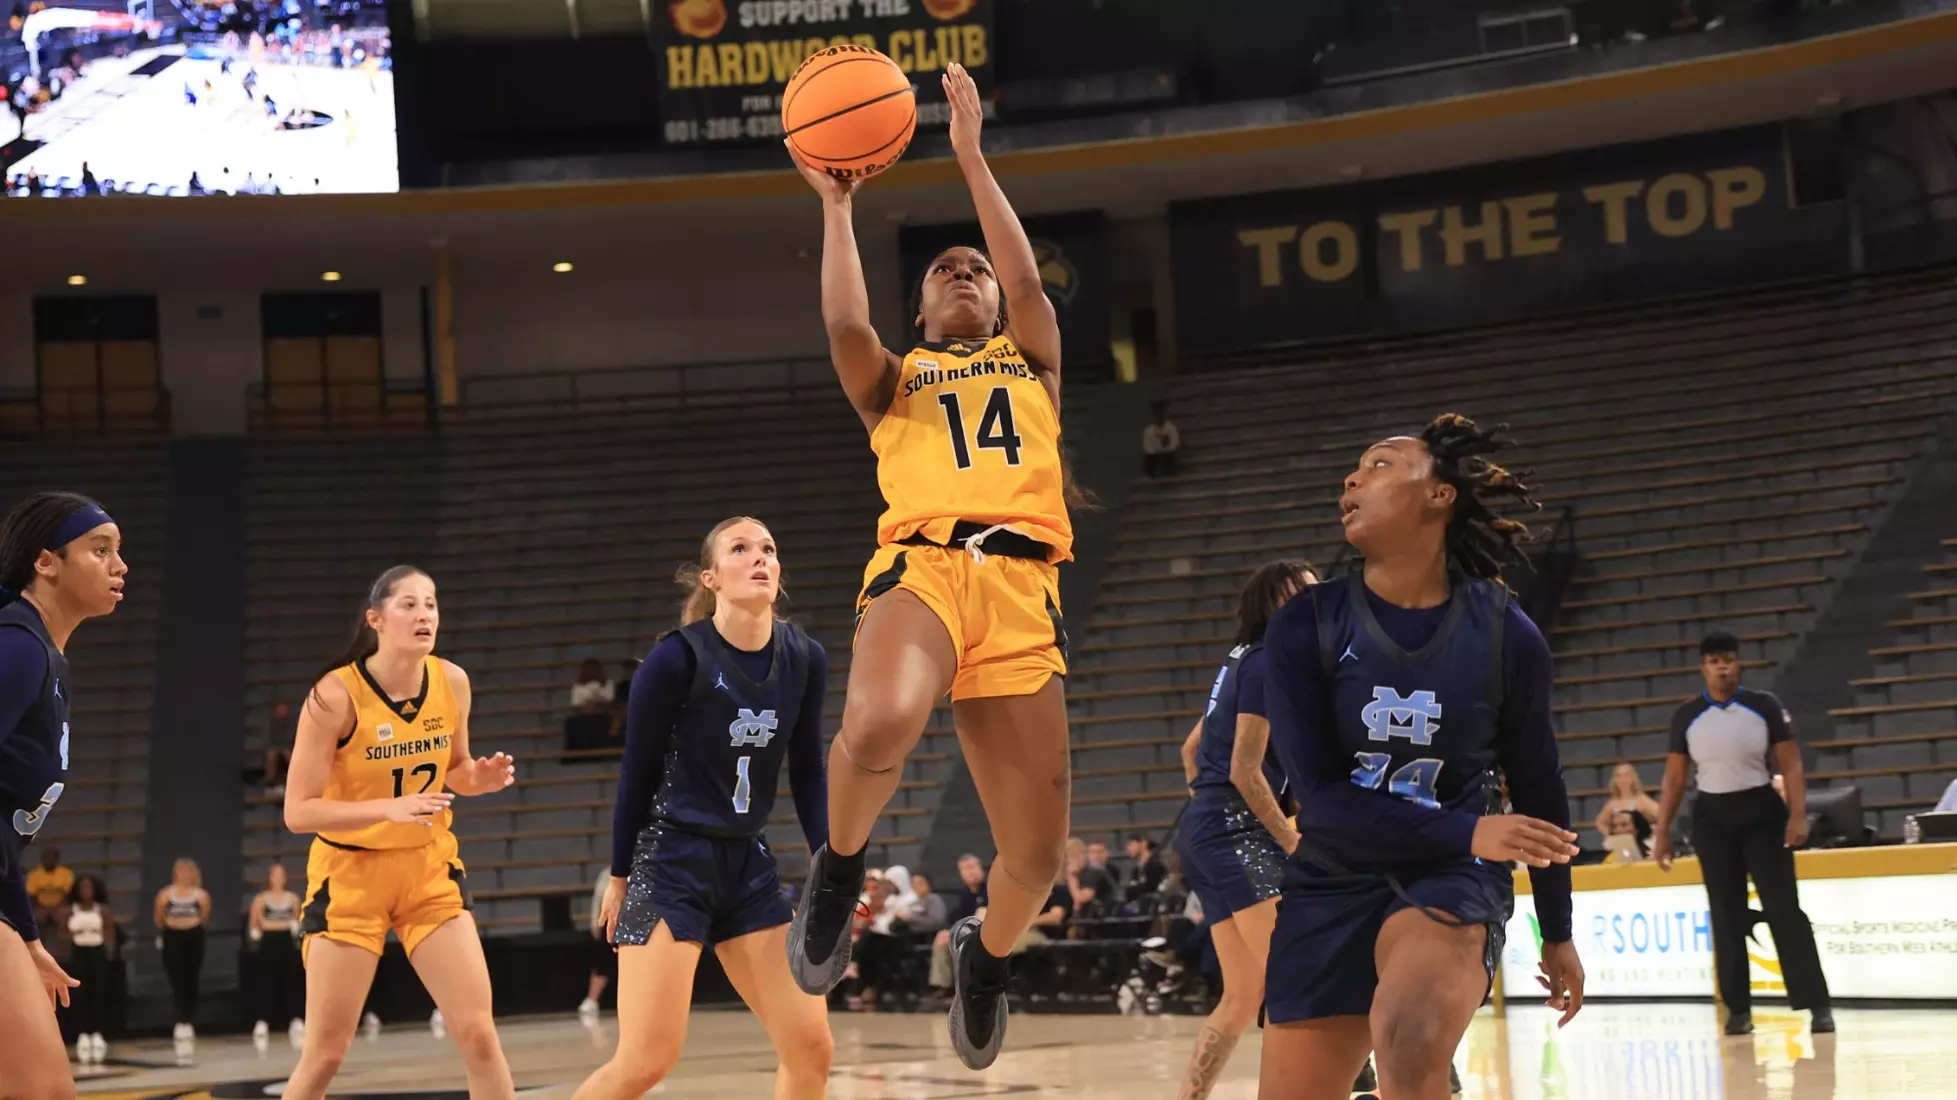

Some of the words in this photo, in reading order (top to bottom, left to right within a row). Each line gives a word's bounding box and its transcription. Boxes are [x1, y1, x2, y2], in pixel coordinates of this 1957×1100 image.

[738, 0, 850, 28] SUPPORT
[667, 33, 876, 90] HARDWO
[888, 25, 987, 74] CLUB
[1237, 220, 1360, 288] TO
[1377, 193, 1563, 272] THE
[1581, 166, 1766, 245] TOP
[904, 361, 996, 398] SOUTHERN
[936, 385, 1022, 471] 14
[365, 738, 431, 761] SOUTHERN
[433, 734, 453, 751] MIS
[391, 762, 438, 799] 12
[732, 756, 751, 814] 1
